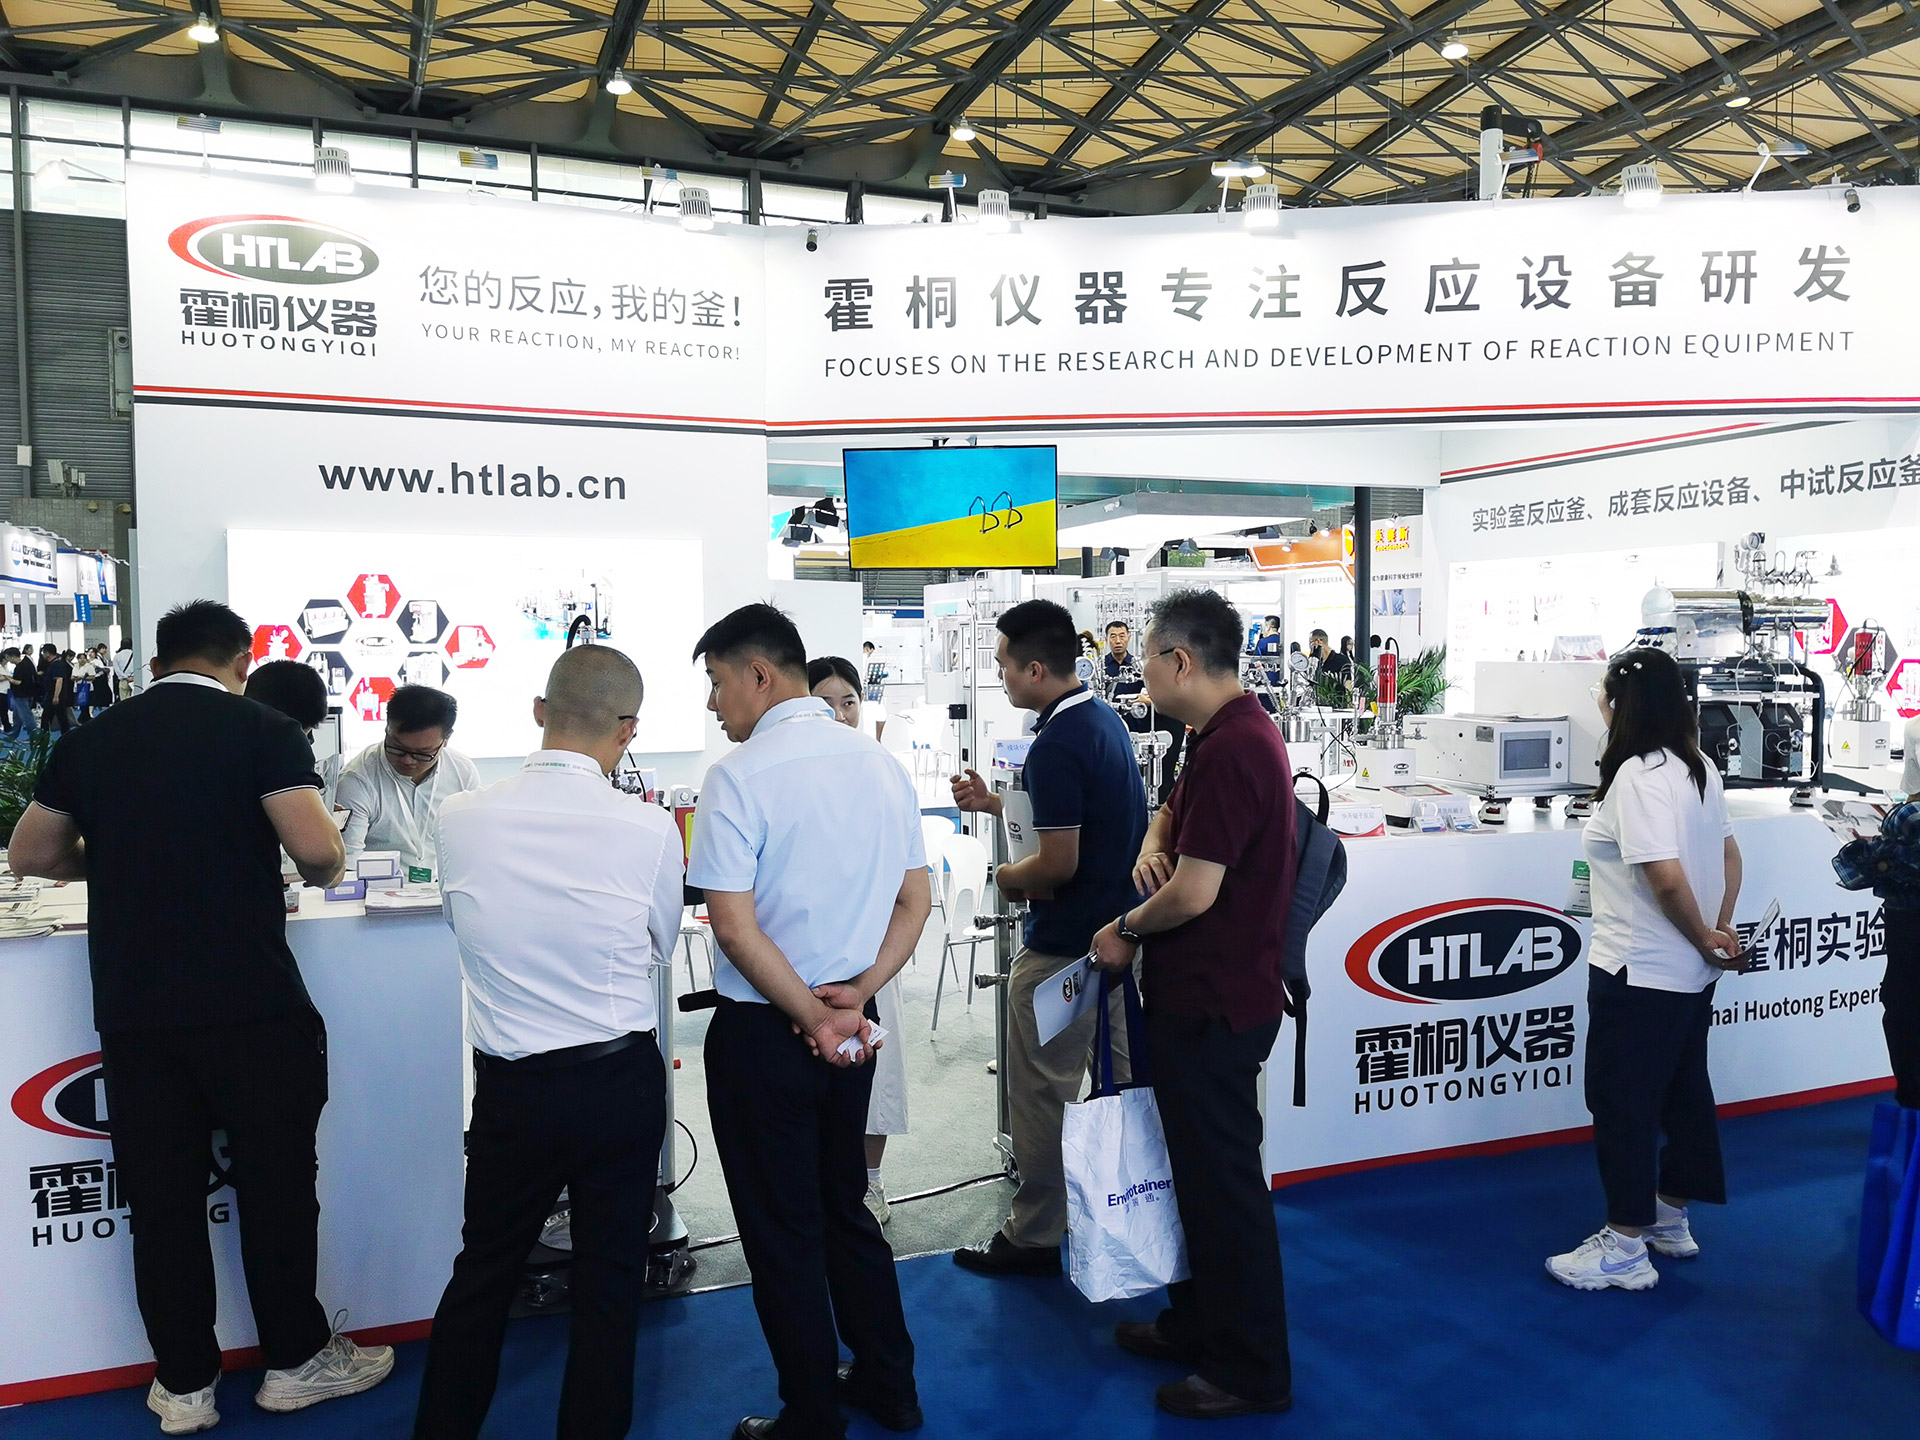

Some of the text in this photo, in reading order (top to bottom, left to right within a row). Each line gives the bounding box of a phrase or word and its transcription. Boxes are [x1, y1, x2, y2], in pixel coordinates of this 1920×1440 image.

[221, 233, 365, 275] HTLAB
[823, 245, 1853, 332] 霍桐仪器专注反应设备研发
[179, 287, 378, 338] 霍桐仪器
[181, 330, 377, 357] HUOTONGYIQI
[421, 322, 740, 361] YOUR REACTION, MY REACTOR!
[825, 331, 1854, 378] FOCUSES ON THE RESEARCH AND DEVELOPMENT OF REACTION EQUIPMENT
[317, 461, 626, 500] www.htlab.cn
[1407, 926, 1564, 985] HTLAB
[1744, 995, 1825, 1021] Huotong
[1829, 987, 1883, 1013] Exper
[1355, 1004, 1576, 1086] 霍桐仪器
[1354, 1063, 1573, 1115] HUOTONGYIQI
